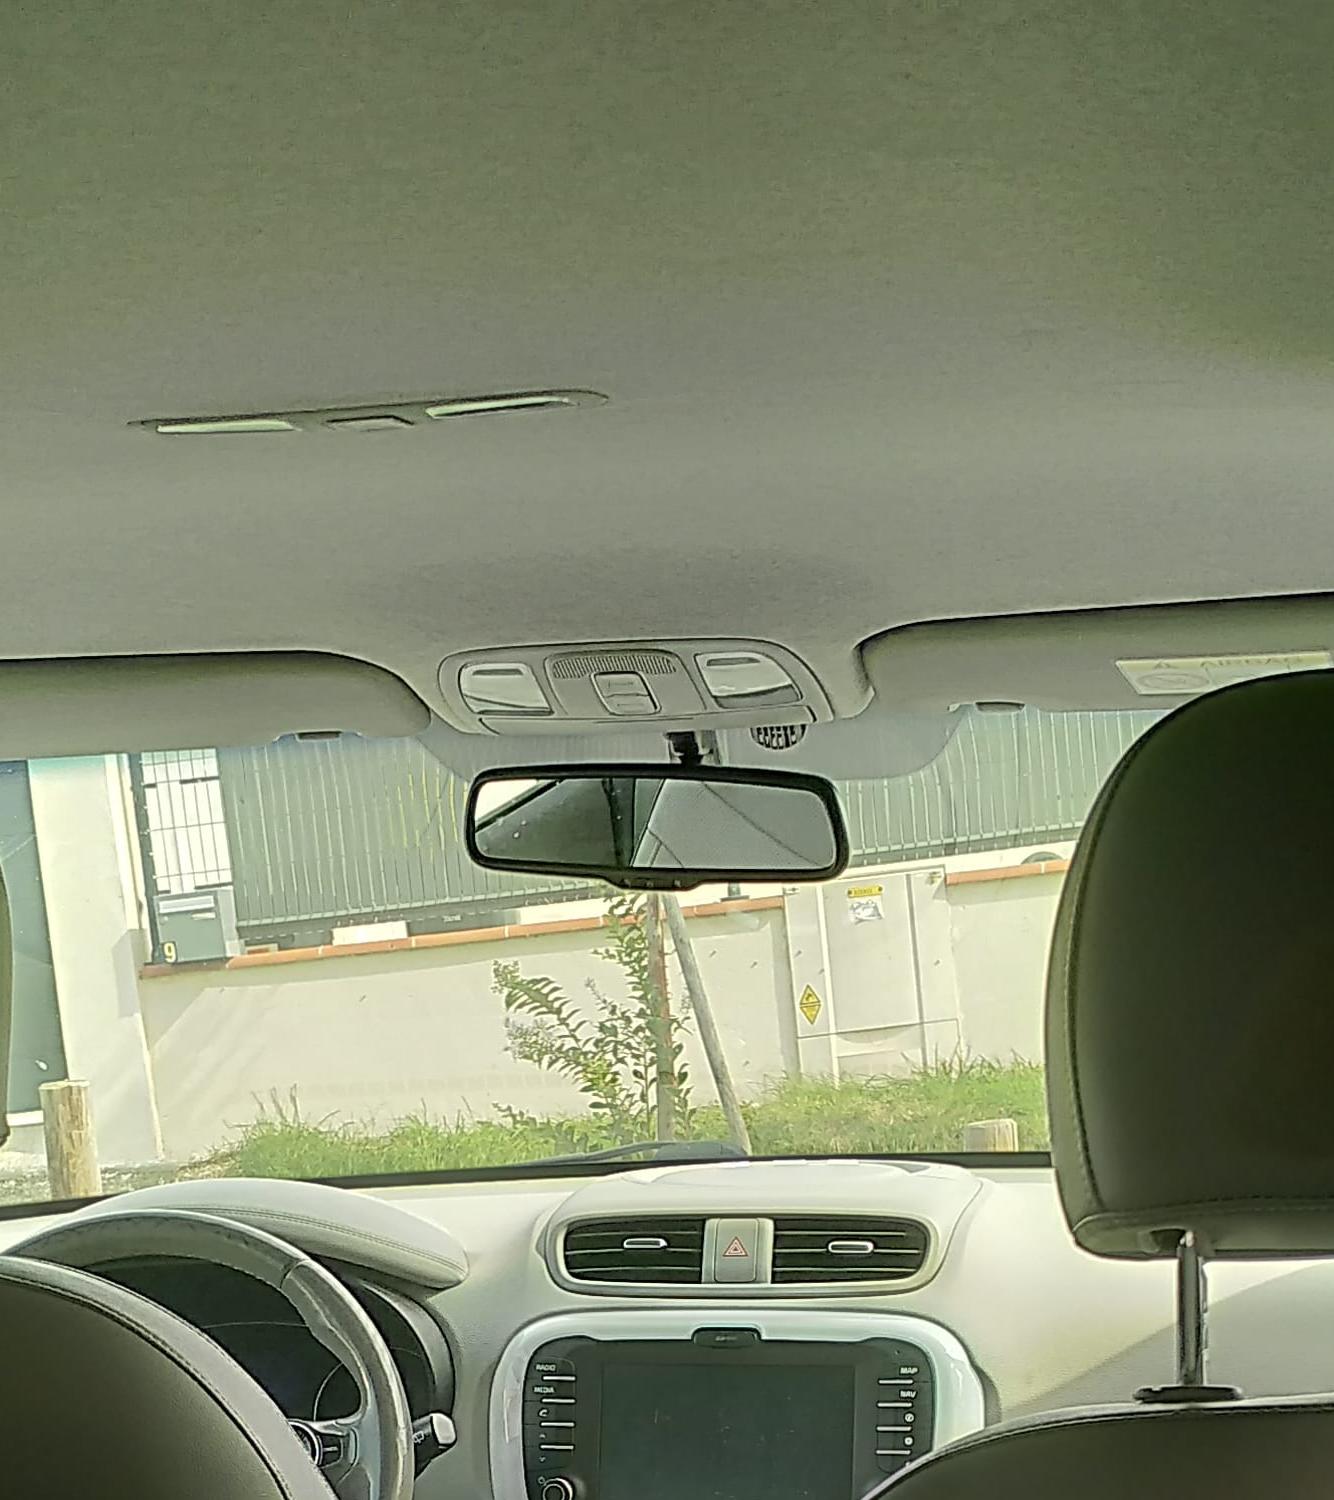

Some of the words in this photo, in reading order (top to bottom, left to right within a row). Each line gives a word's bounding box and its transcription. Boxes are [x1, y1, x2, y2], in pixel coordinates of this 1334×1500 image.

[164, 942, 176, 963] 9
[535, 1363, 556, 1372] RADIO
[900, 1390, 916, 1398] NAV
